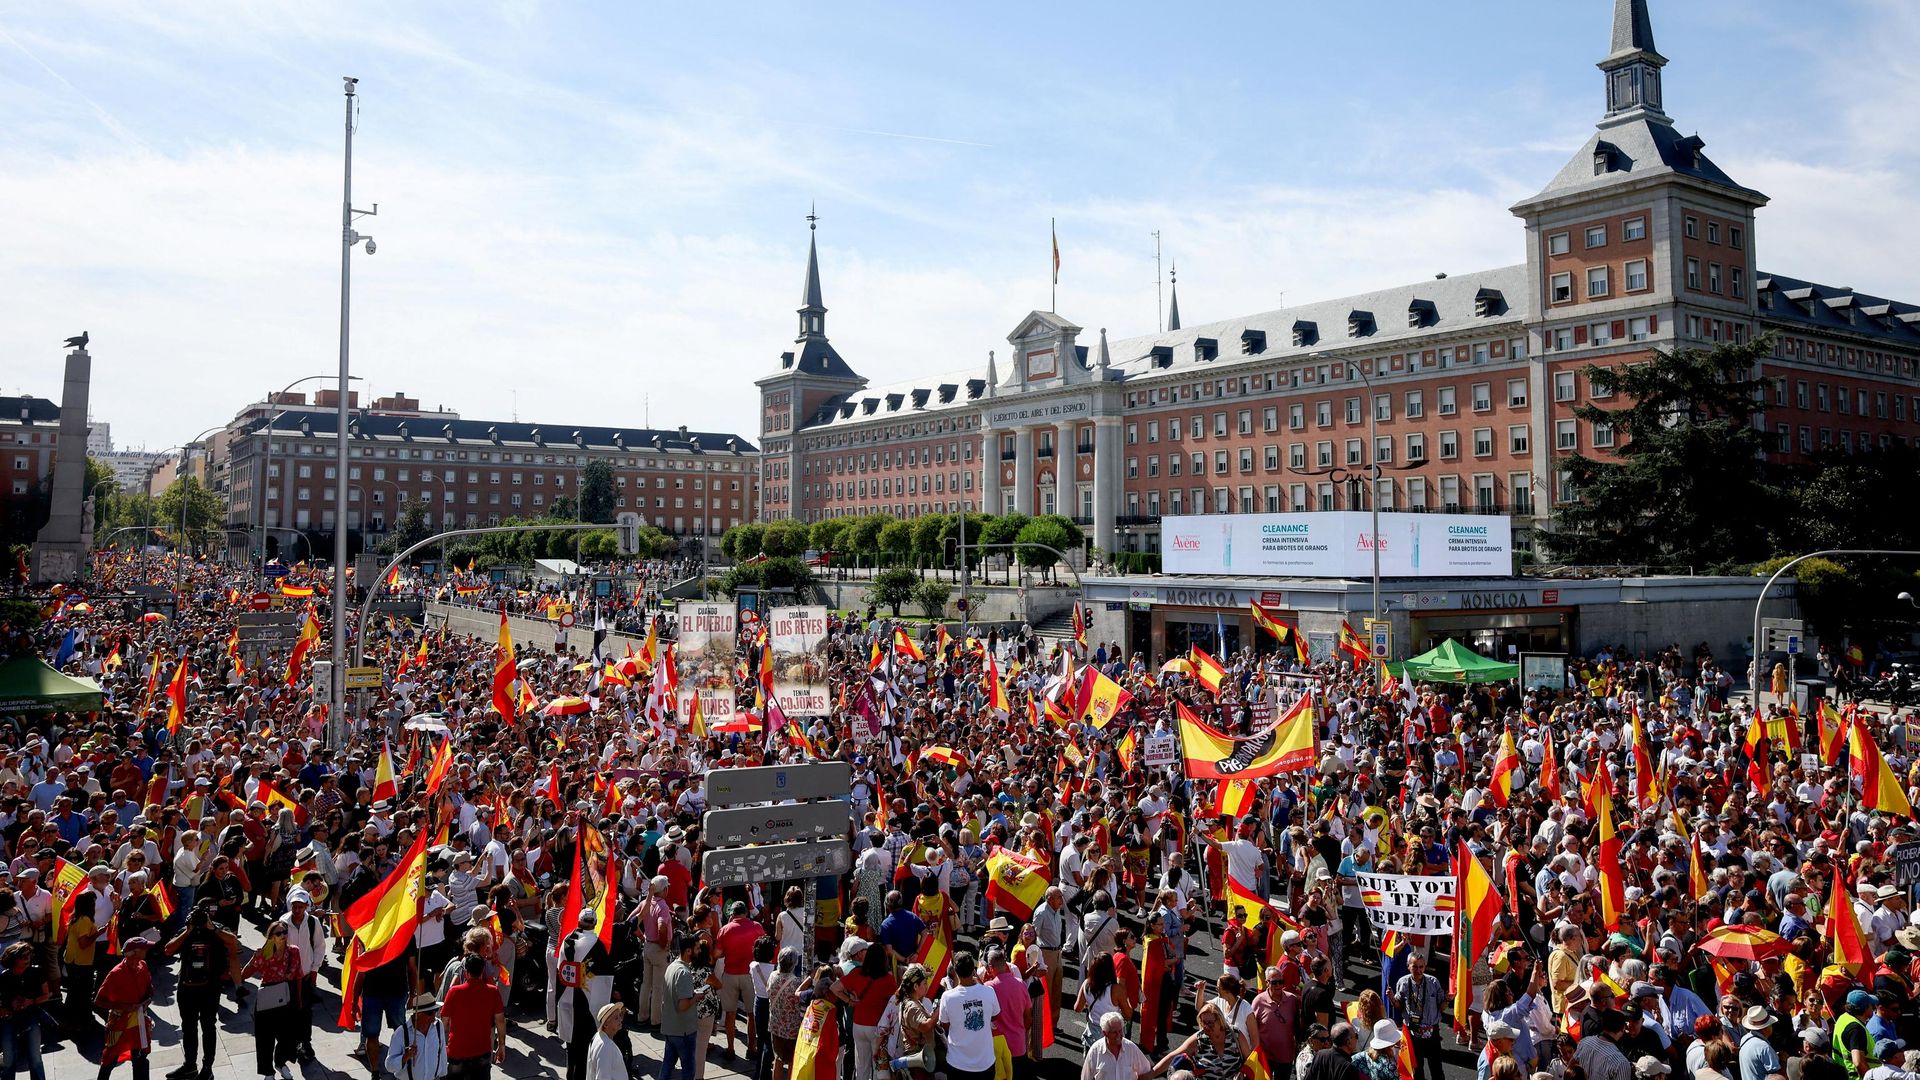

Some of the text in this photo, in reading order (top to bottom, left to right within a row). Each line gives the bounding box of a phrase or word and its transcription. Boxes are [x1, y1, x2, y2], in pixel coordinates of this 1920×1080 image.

[1019, 410, 1029, 419] DEL
[1031, 409, 1044, 418] AIRE
[1051, 406, 1061, 415] DEL
[1063, 403, 1086, 413] ESPACIO
[1262, 524, 1308, 532] CLEANANCE
[1448, 526, 1487, 534] CLEANANCE
[1166, 590, 1238, 606] MONCLOA
[1461, 593, 1527, 608] MONCLOA
[683, 616, 732, 632] EL PUEBLO
[776, 619, 822, 636] LOS REYES
[683, 698, 730, 715] CONES
[781, 696, 824, 710] COJONES
[1218, 758, 1243, 773] Pie
[1357, 876, 1397, 892] QUE
[1390, 892, 1420, 907] TE
